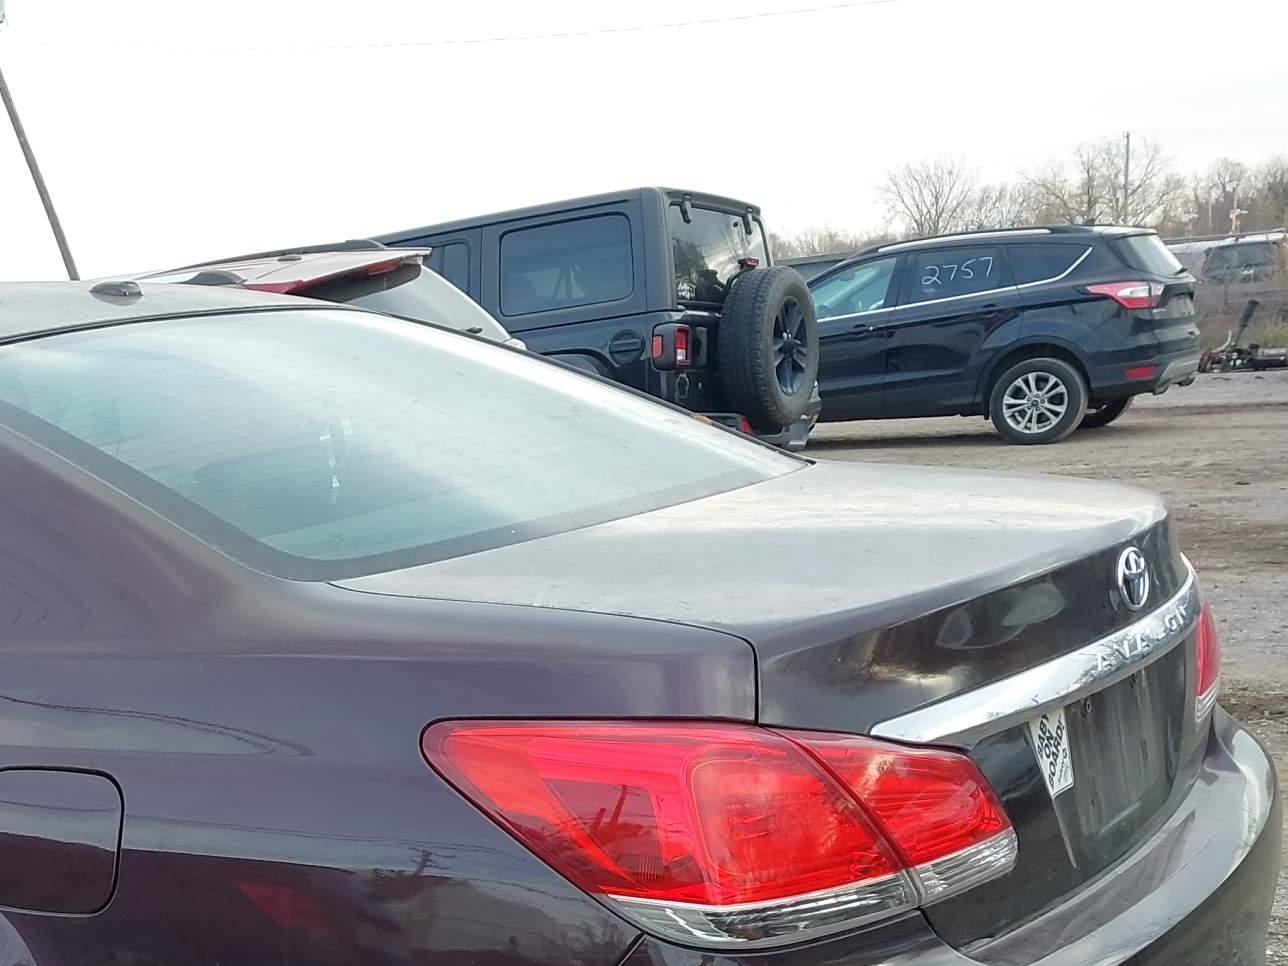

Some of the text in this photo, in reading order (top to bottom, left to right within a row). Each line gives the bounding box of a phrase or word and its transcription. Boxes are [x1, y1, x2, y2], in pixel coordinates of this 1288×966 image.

[921, 256, 993, 285] 2757
[1036, 713, 1050, 760] BABY
[1043, 728, 1054, 759] ON
